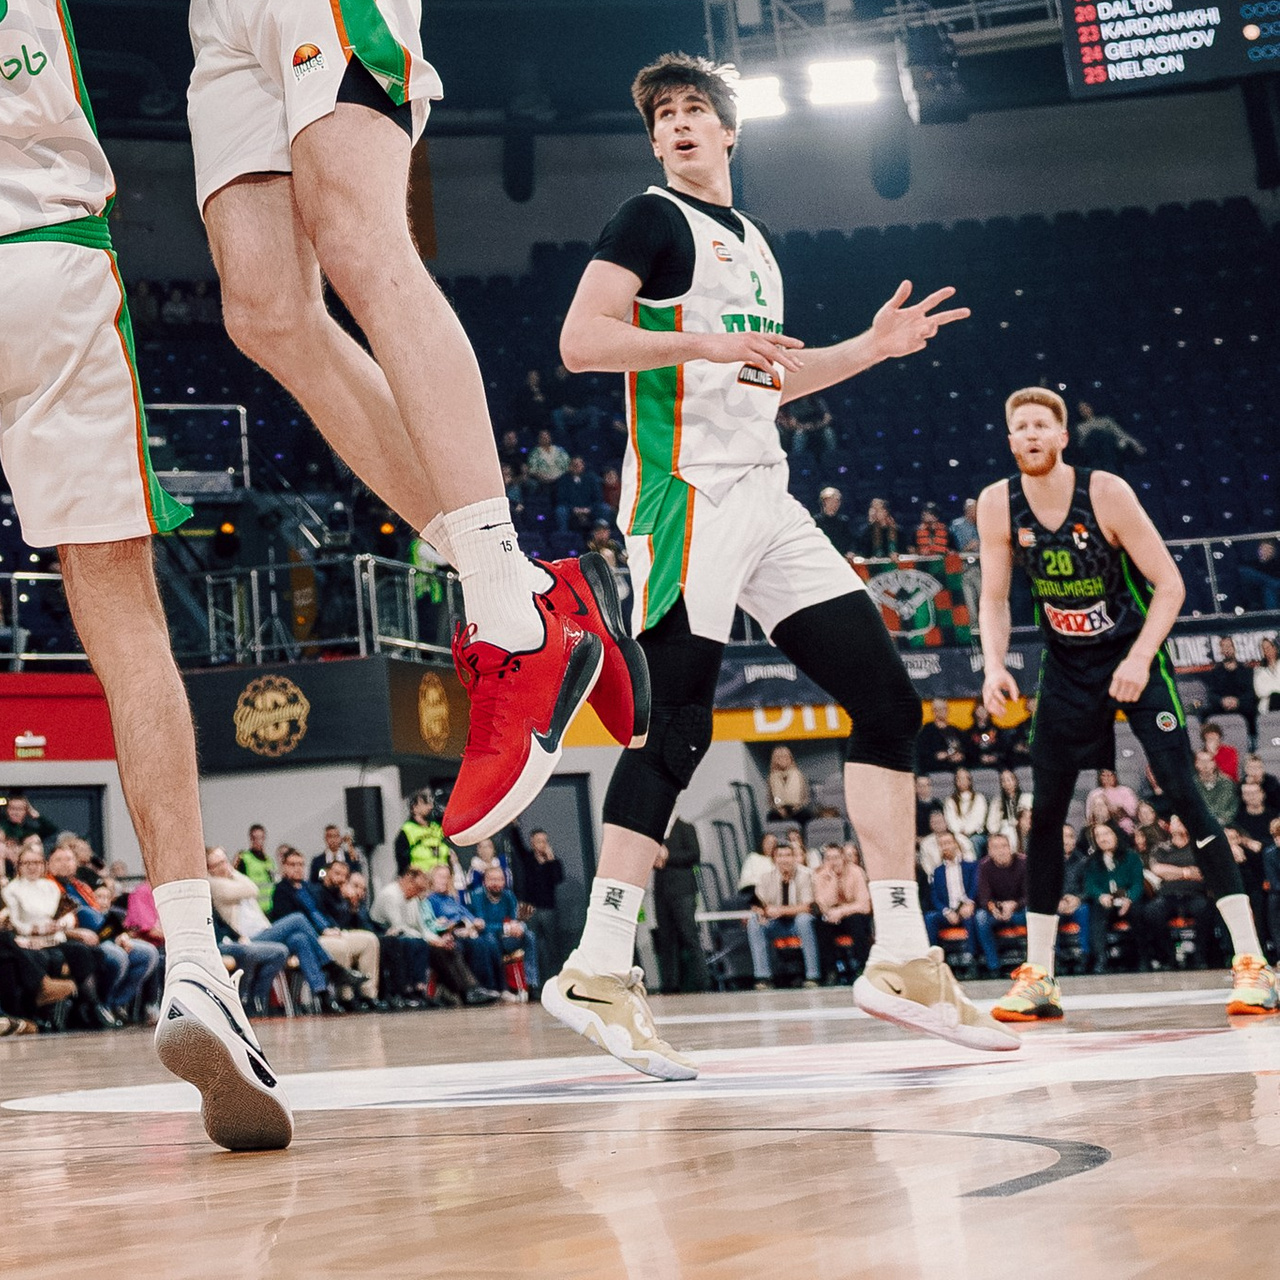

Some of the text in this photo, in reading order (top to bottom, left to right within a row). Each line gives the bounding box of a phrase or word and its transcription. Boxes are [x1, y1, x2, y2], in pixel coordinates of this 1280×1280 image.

[1100, 6, 1221, 40] KARDANAKHI
[1104, 28, 1215, 60] GERASIMOV
[1107, 54, 1185, 81] NELSON
[750, 270, 767, 307] 2
[500, 540, 513, 553] 15
[1042, 549, 1074, 576] 20
[1167, 635, 1213, 667] LINE
